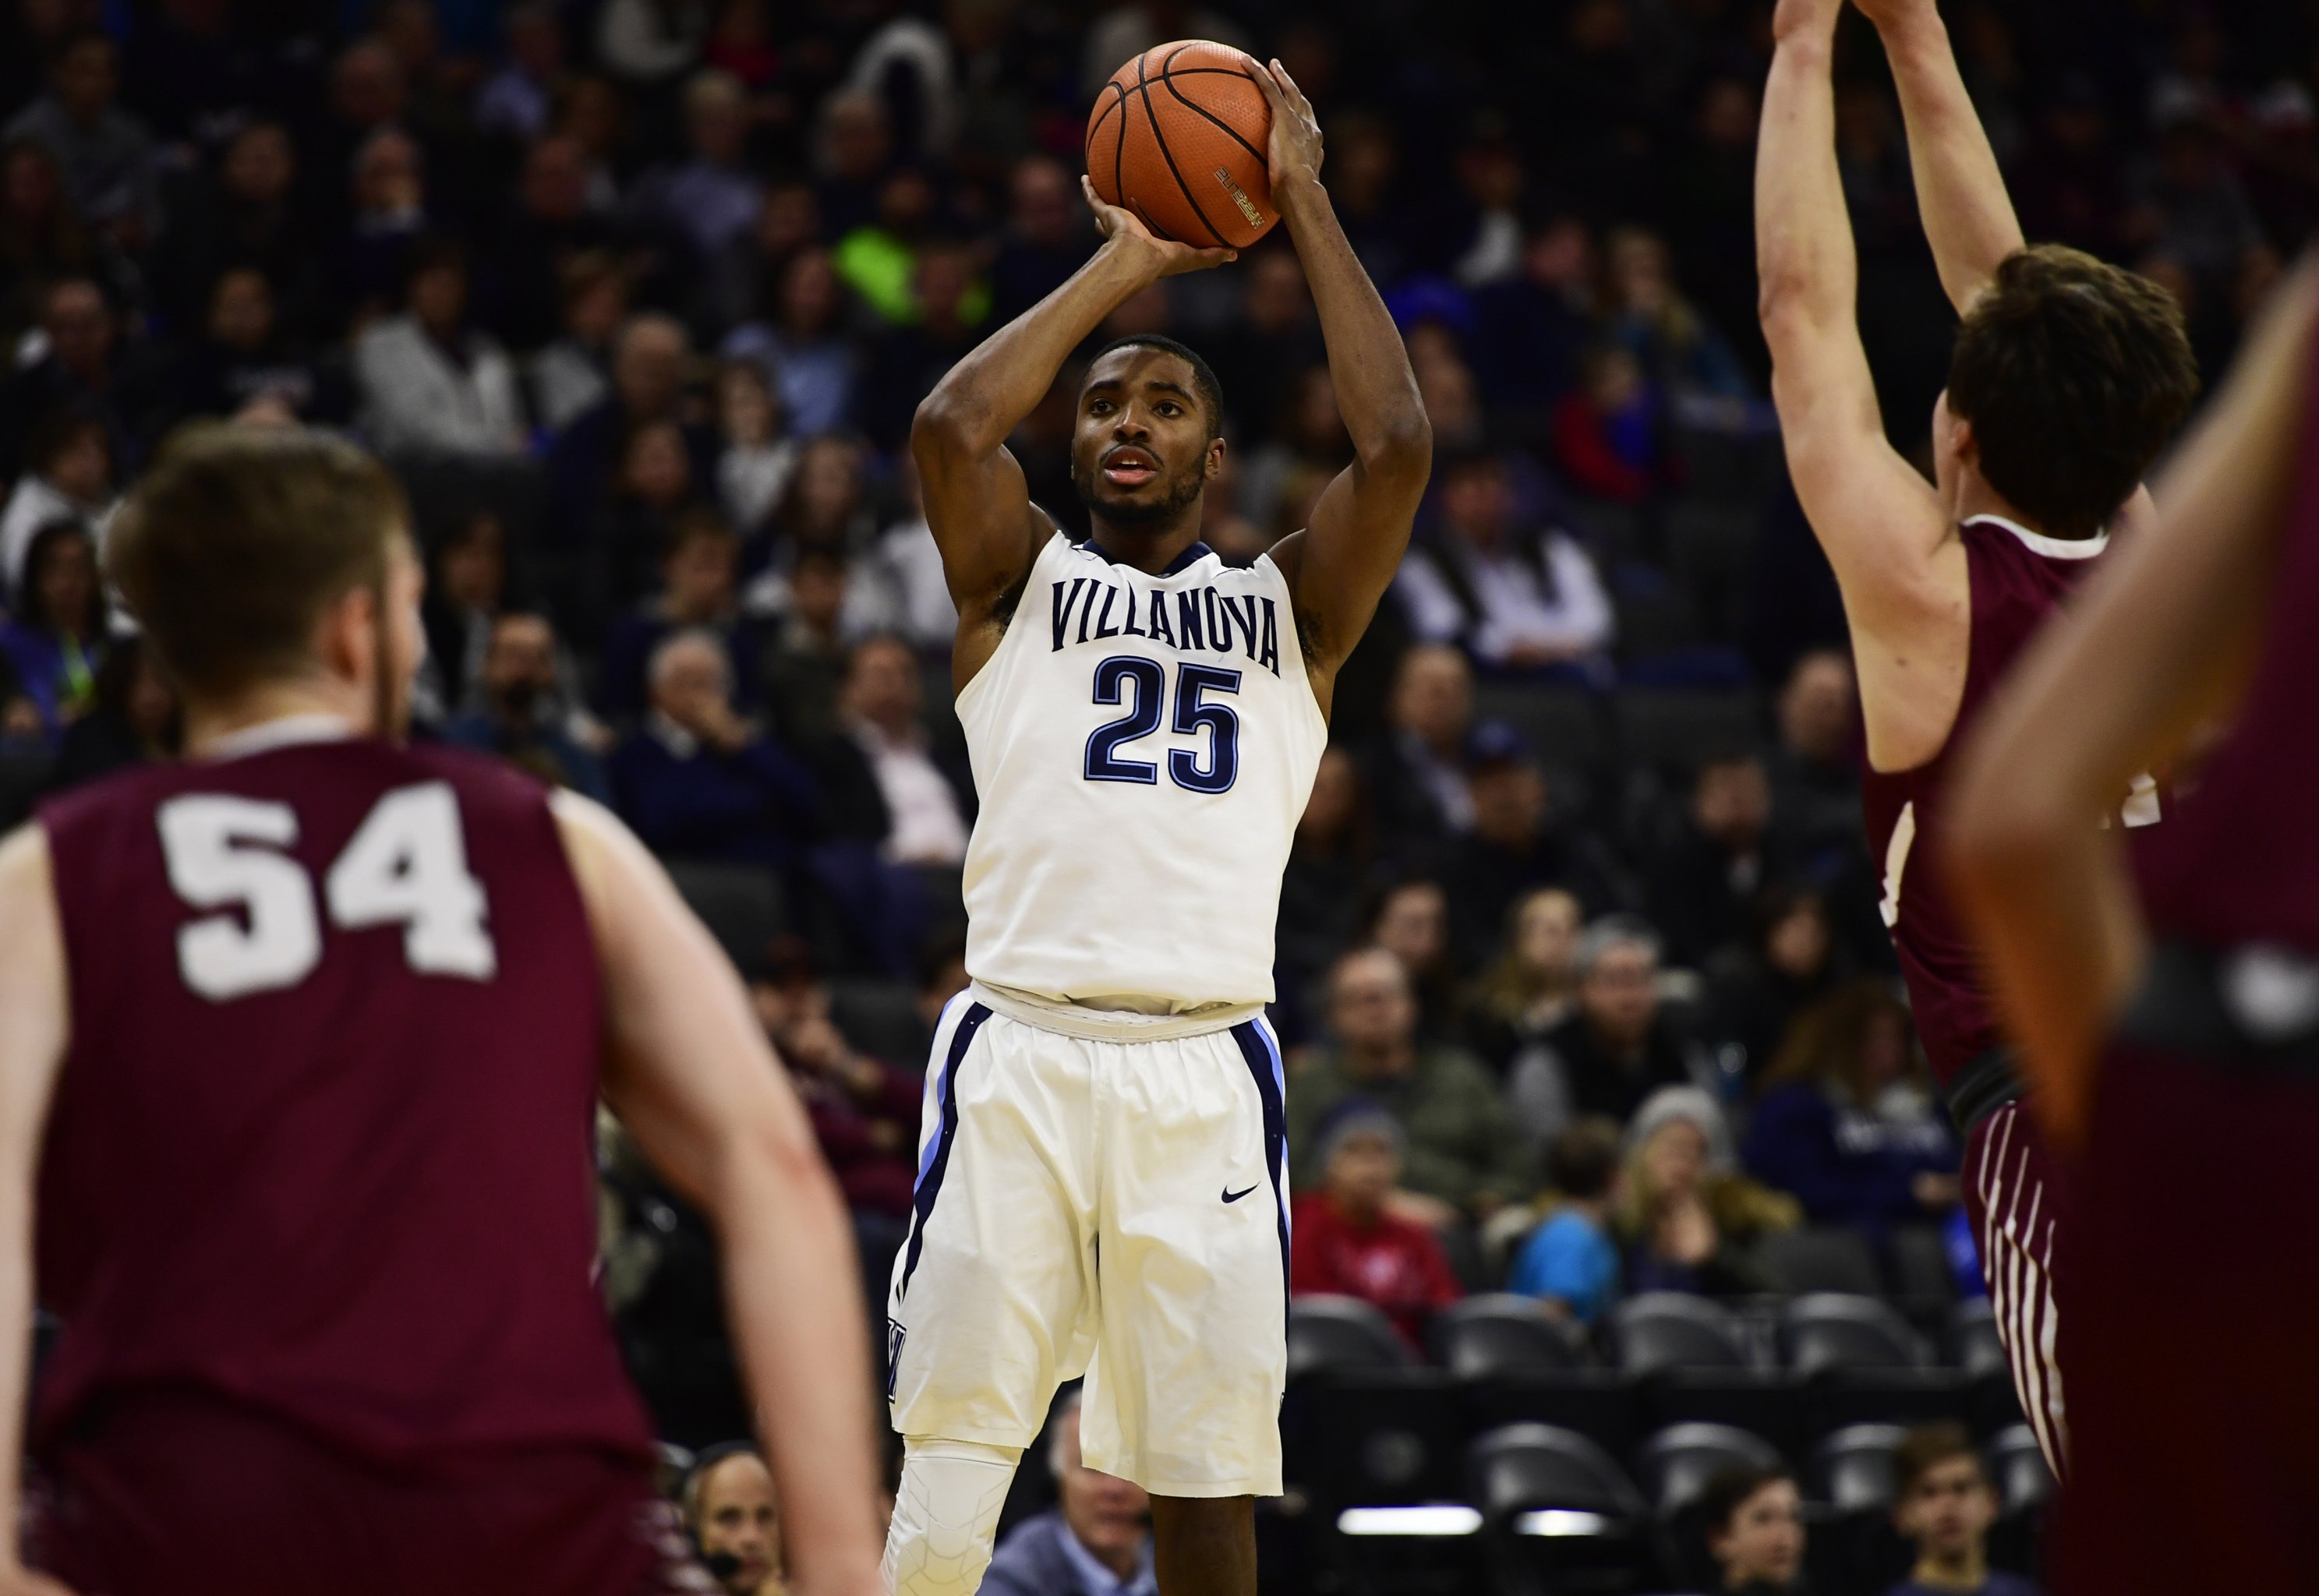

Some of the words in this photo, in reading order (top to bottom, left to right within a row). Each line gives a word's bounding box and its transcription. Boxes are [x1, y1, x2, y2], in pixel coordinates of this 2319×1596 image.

[1052, 577, 1281, 679] VILLANOVA
[1083, 655, 1243, 794] 25
[156, 778, 499, 1003] 54
